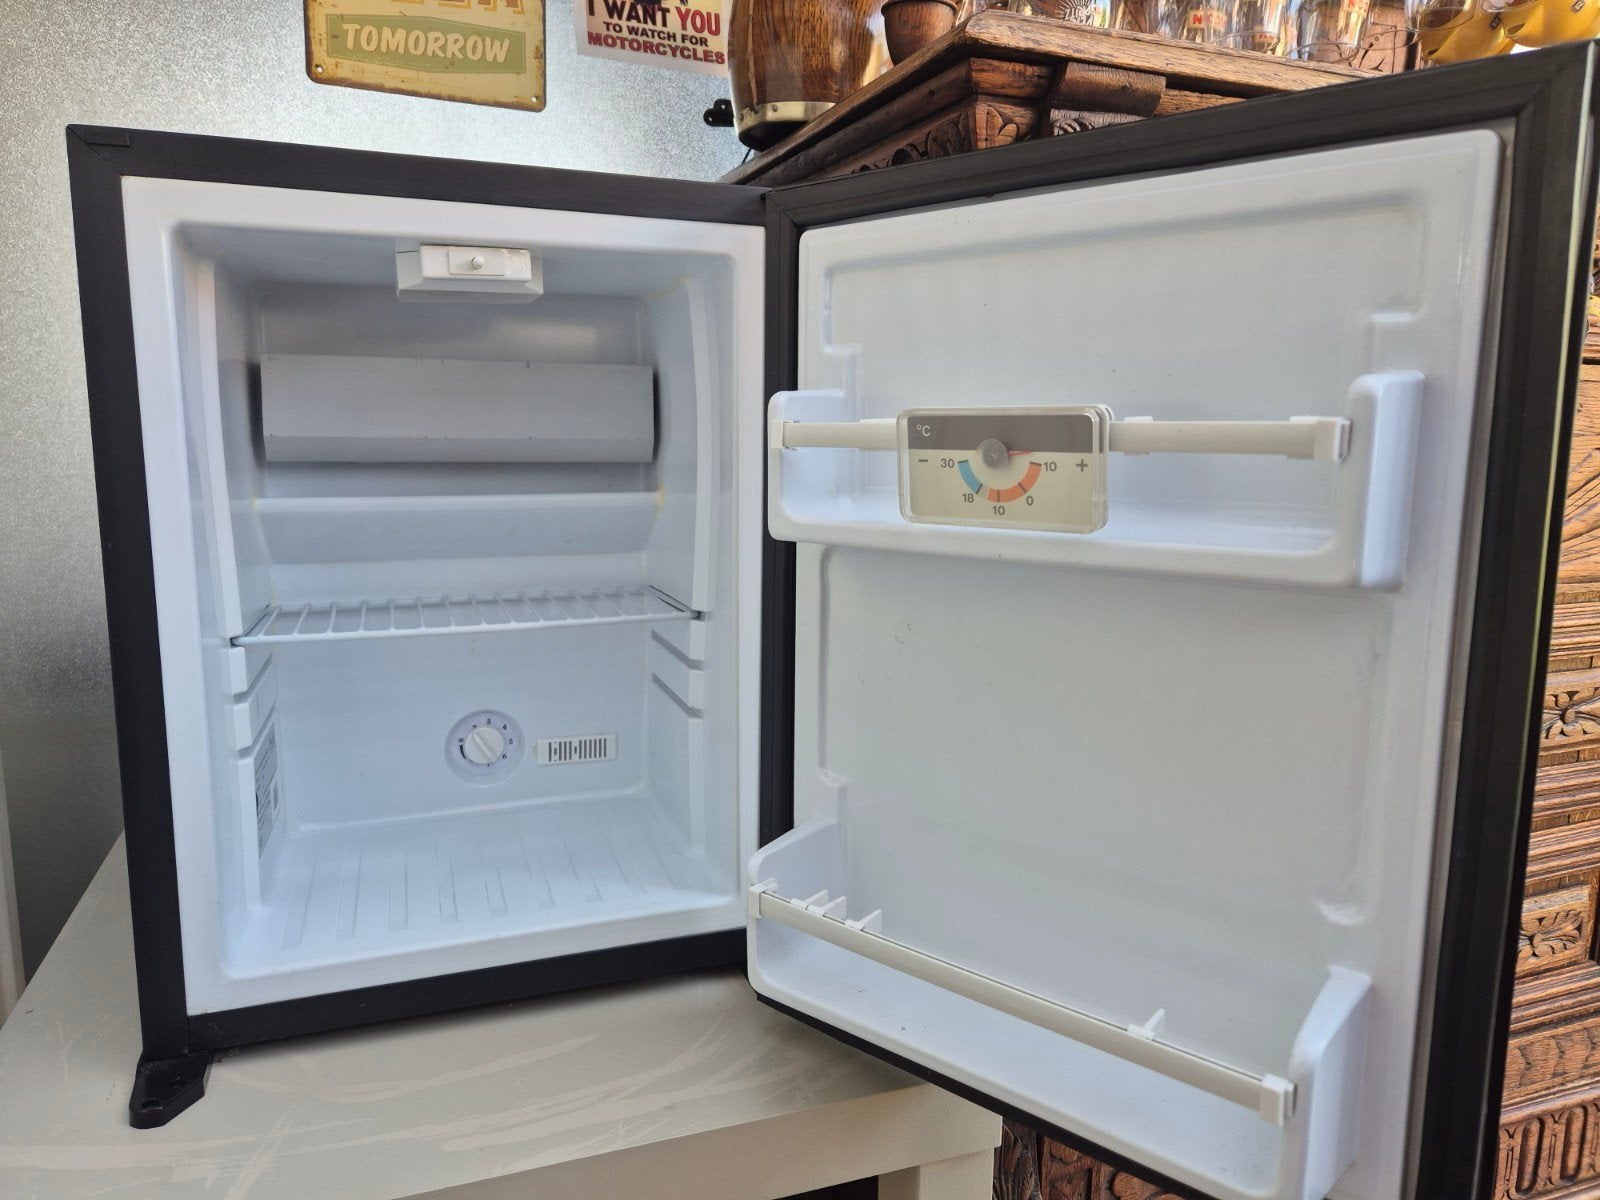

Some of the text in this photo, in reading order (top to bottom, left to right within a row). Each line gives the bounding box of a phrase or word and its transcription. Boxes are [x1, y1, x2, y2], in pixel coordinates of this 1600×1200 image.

[587, 0, 721, 37] I WANT YOU
[602, 21, 709, 48] TO WATCH FOR
[341, 22, 511, 64] TOMORROW
[587, 31, 726, 65] MOTORCYCLES
[940, 458, 955, 469] 30
[1043, 461, 1058, 472] 10
[961, 493, 975, 504] 18
[1026, 495, 1035, 506] 0
[991, 505, 1006, 516] 10
